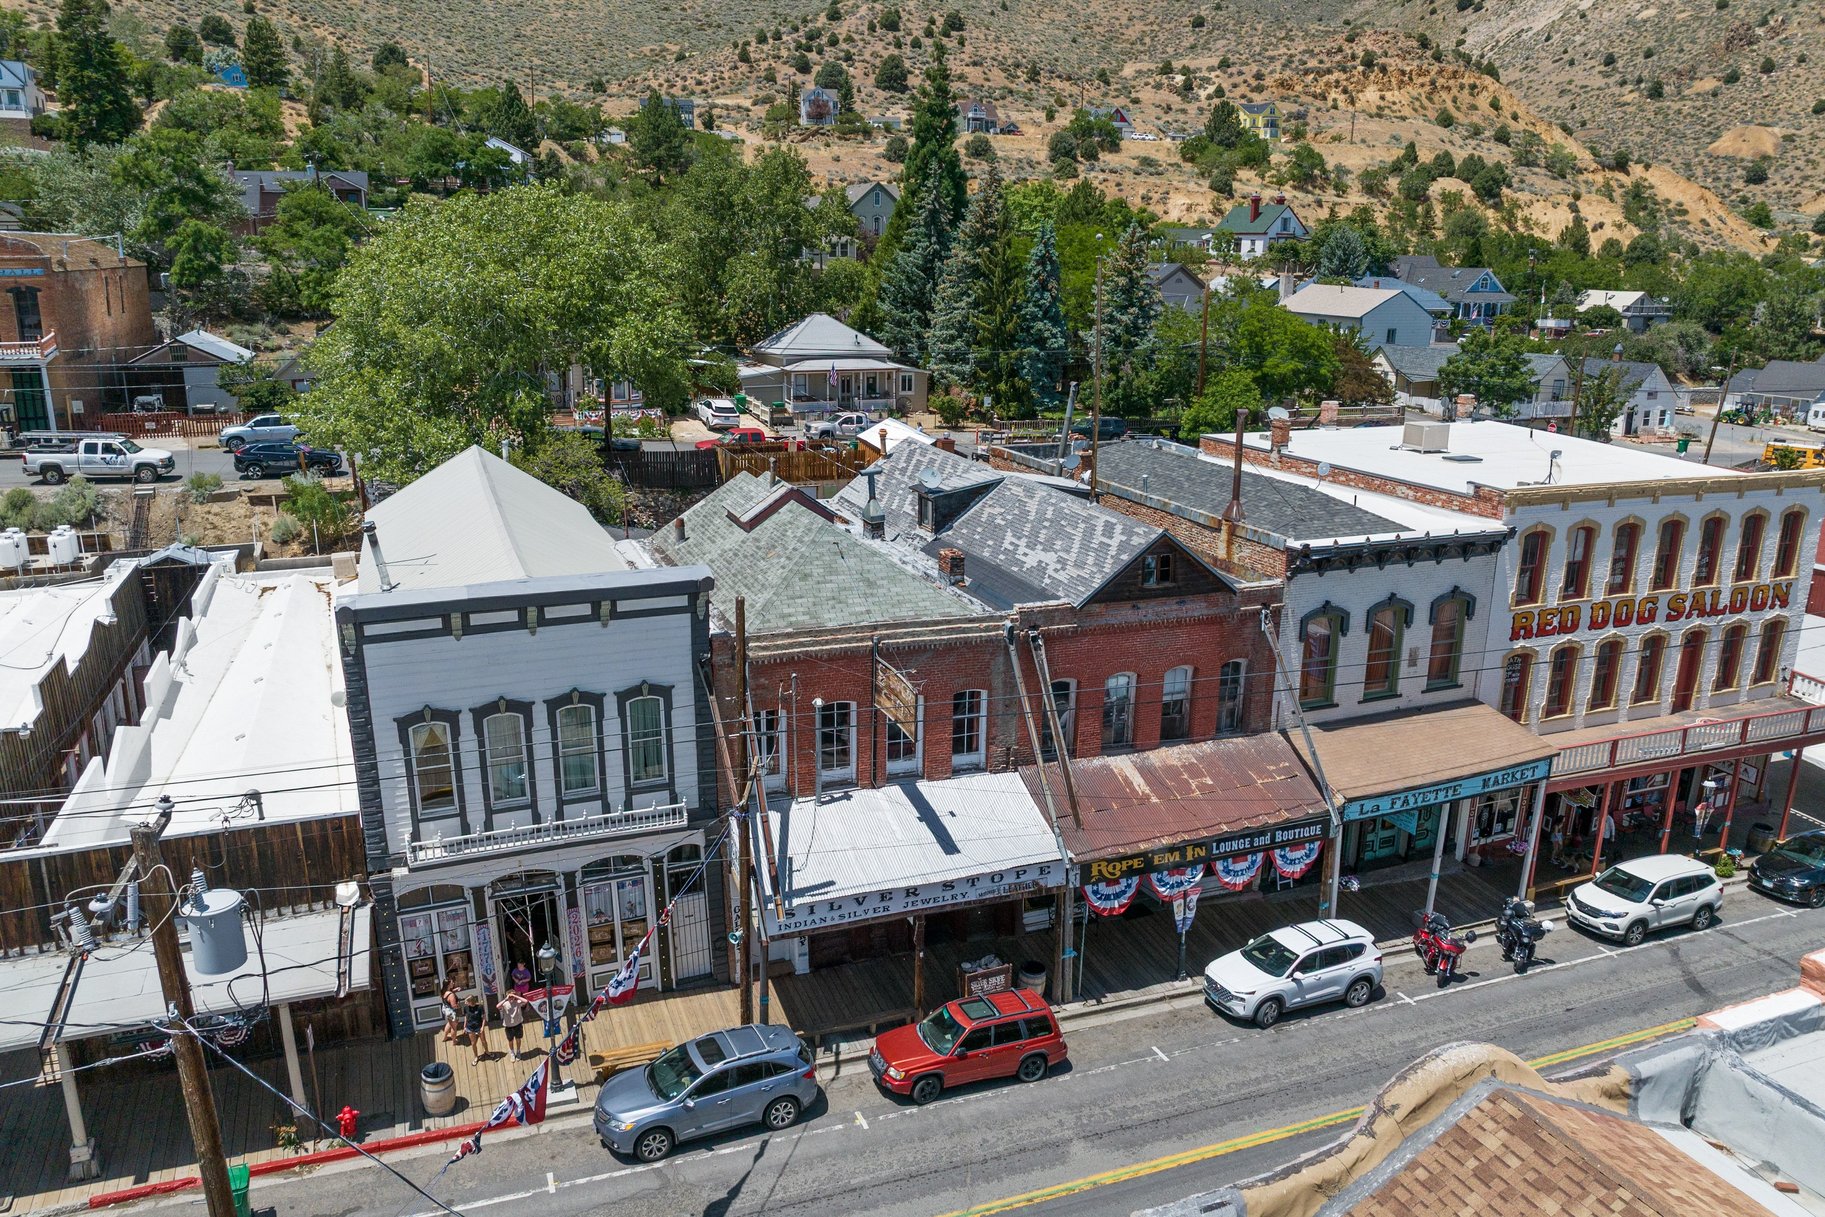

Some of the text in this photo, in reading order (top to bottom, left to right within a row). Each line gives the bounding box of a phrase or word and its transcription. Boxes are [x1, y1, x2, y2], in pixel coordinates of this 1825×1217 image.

[1509, 583, 1793, 641] RED DOG SALOON
[1358, 765, 1540, 816] La FAYETTE MARKET
[1253, 834, 1270, 846] and
[785, 888, 921, 919] SILVER
[943, 865, 1051, 892] STOPE
[572, 914, 582, 957] 2026
[778, 916, 828, 931] INDIAN
[838, 905, 891, 920] SILVER
[482, 929, 492, 975] 1776
